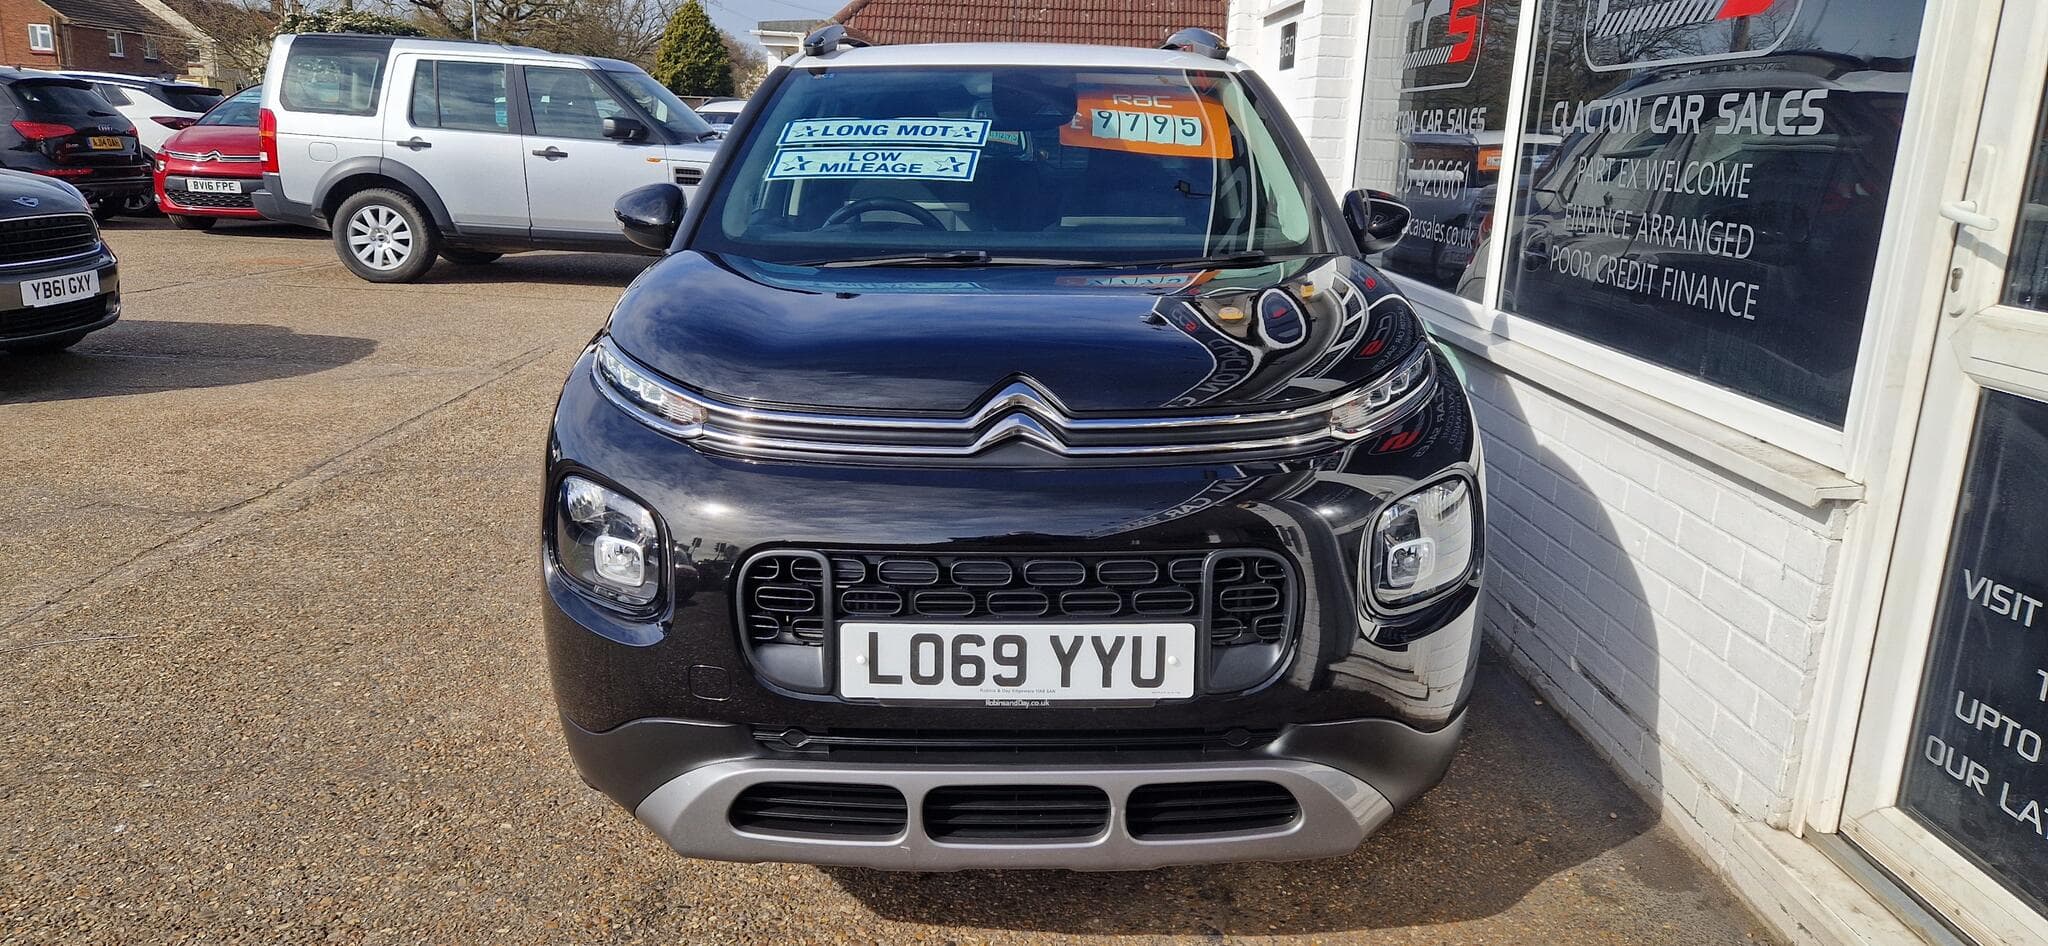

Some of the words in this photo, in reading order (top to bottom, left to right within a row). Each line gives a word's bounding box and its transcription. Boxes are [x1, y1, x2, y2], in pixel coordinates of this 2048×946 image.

[821, 124, 889, 137] LONG
[896, 125, 953, 137] MOT
[1420, 108, 1443, 135] CAR
[1446, 106, 1487, 136] SALES
[1551, 97, 1642, 135] CLACTON
[1650, 94, 1705, 135] CAR
[1714, 88, 1829, 136] SALES
[818, 162, 923, 174] MILEAGE
[849, 151, 902, 162] LOW
[1576, 156, 1616, 185] PART
[1617, 158, 1639, 189] EX
[1644, 159, 1753, 199] WELCOME
[193, 180, 214, 191] BV16
[216, 181, 235, 191] FPE
[1415, 159, 1471, 201] 426661
[1564, 203, 1634, 240] FINANCE
[1635, 213, 1755, 260] ARRANGED
[31, 278, 67, 300] YB61
[68, 274, 91, 295] GXY
[1550, 245, 1592, 279] POOR
[1596, 254, 1659, 295] CREDIT
[1660, 267, 1760, 321] FINANCE
[1963, 568, 2044, 628] VISIT
[868, 631, 1028, 688] LO69
[1049, 635, 1167, 689] YYU
[1955, 690, 2042, 763] UPTO
[1924, 735, 1990, 797] OUR
